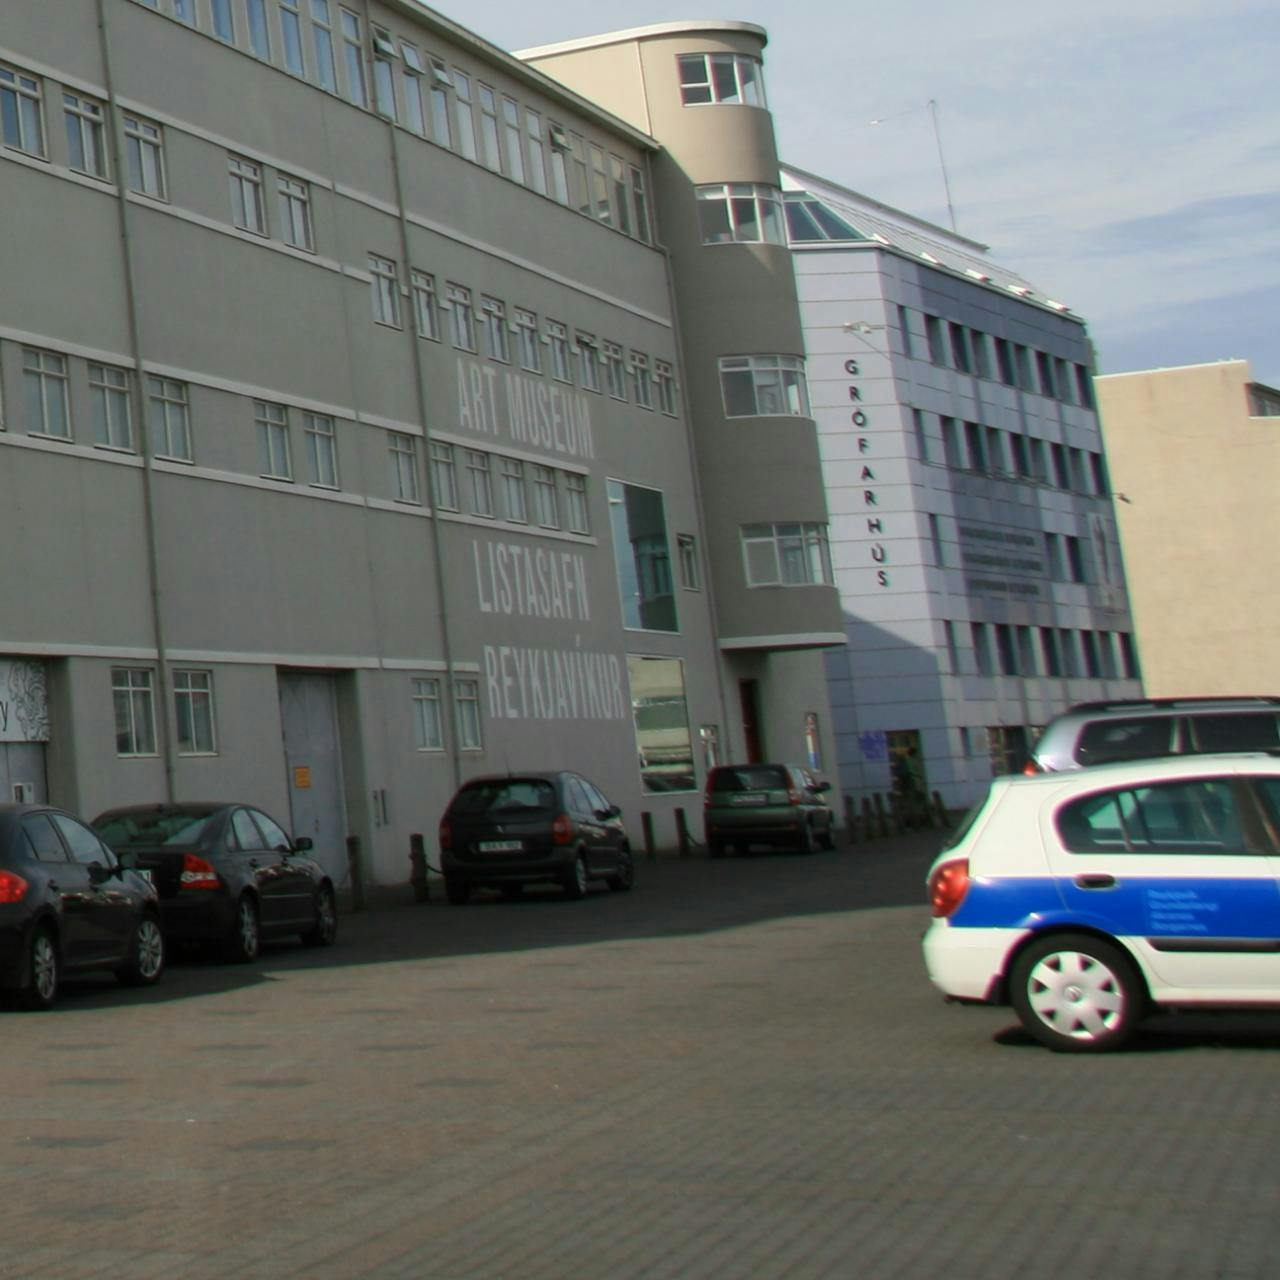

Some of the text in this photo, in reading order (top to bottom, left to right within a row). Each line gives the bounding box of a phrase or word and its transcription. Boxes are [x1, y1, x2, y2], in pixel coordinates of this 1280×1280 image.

[456, 357, 595, 460] ART MUSEUM
[472, 539, 591, 621] LISTASAFN
[484, 634, 626, 720] REYKJAVÍKUR
